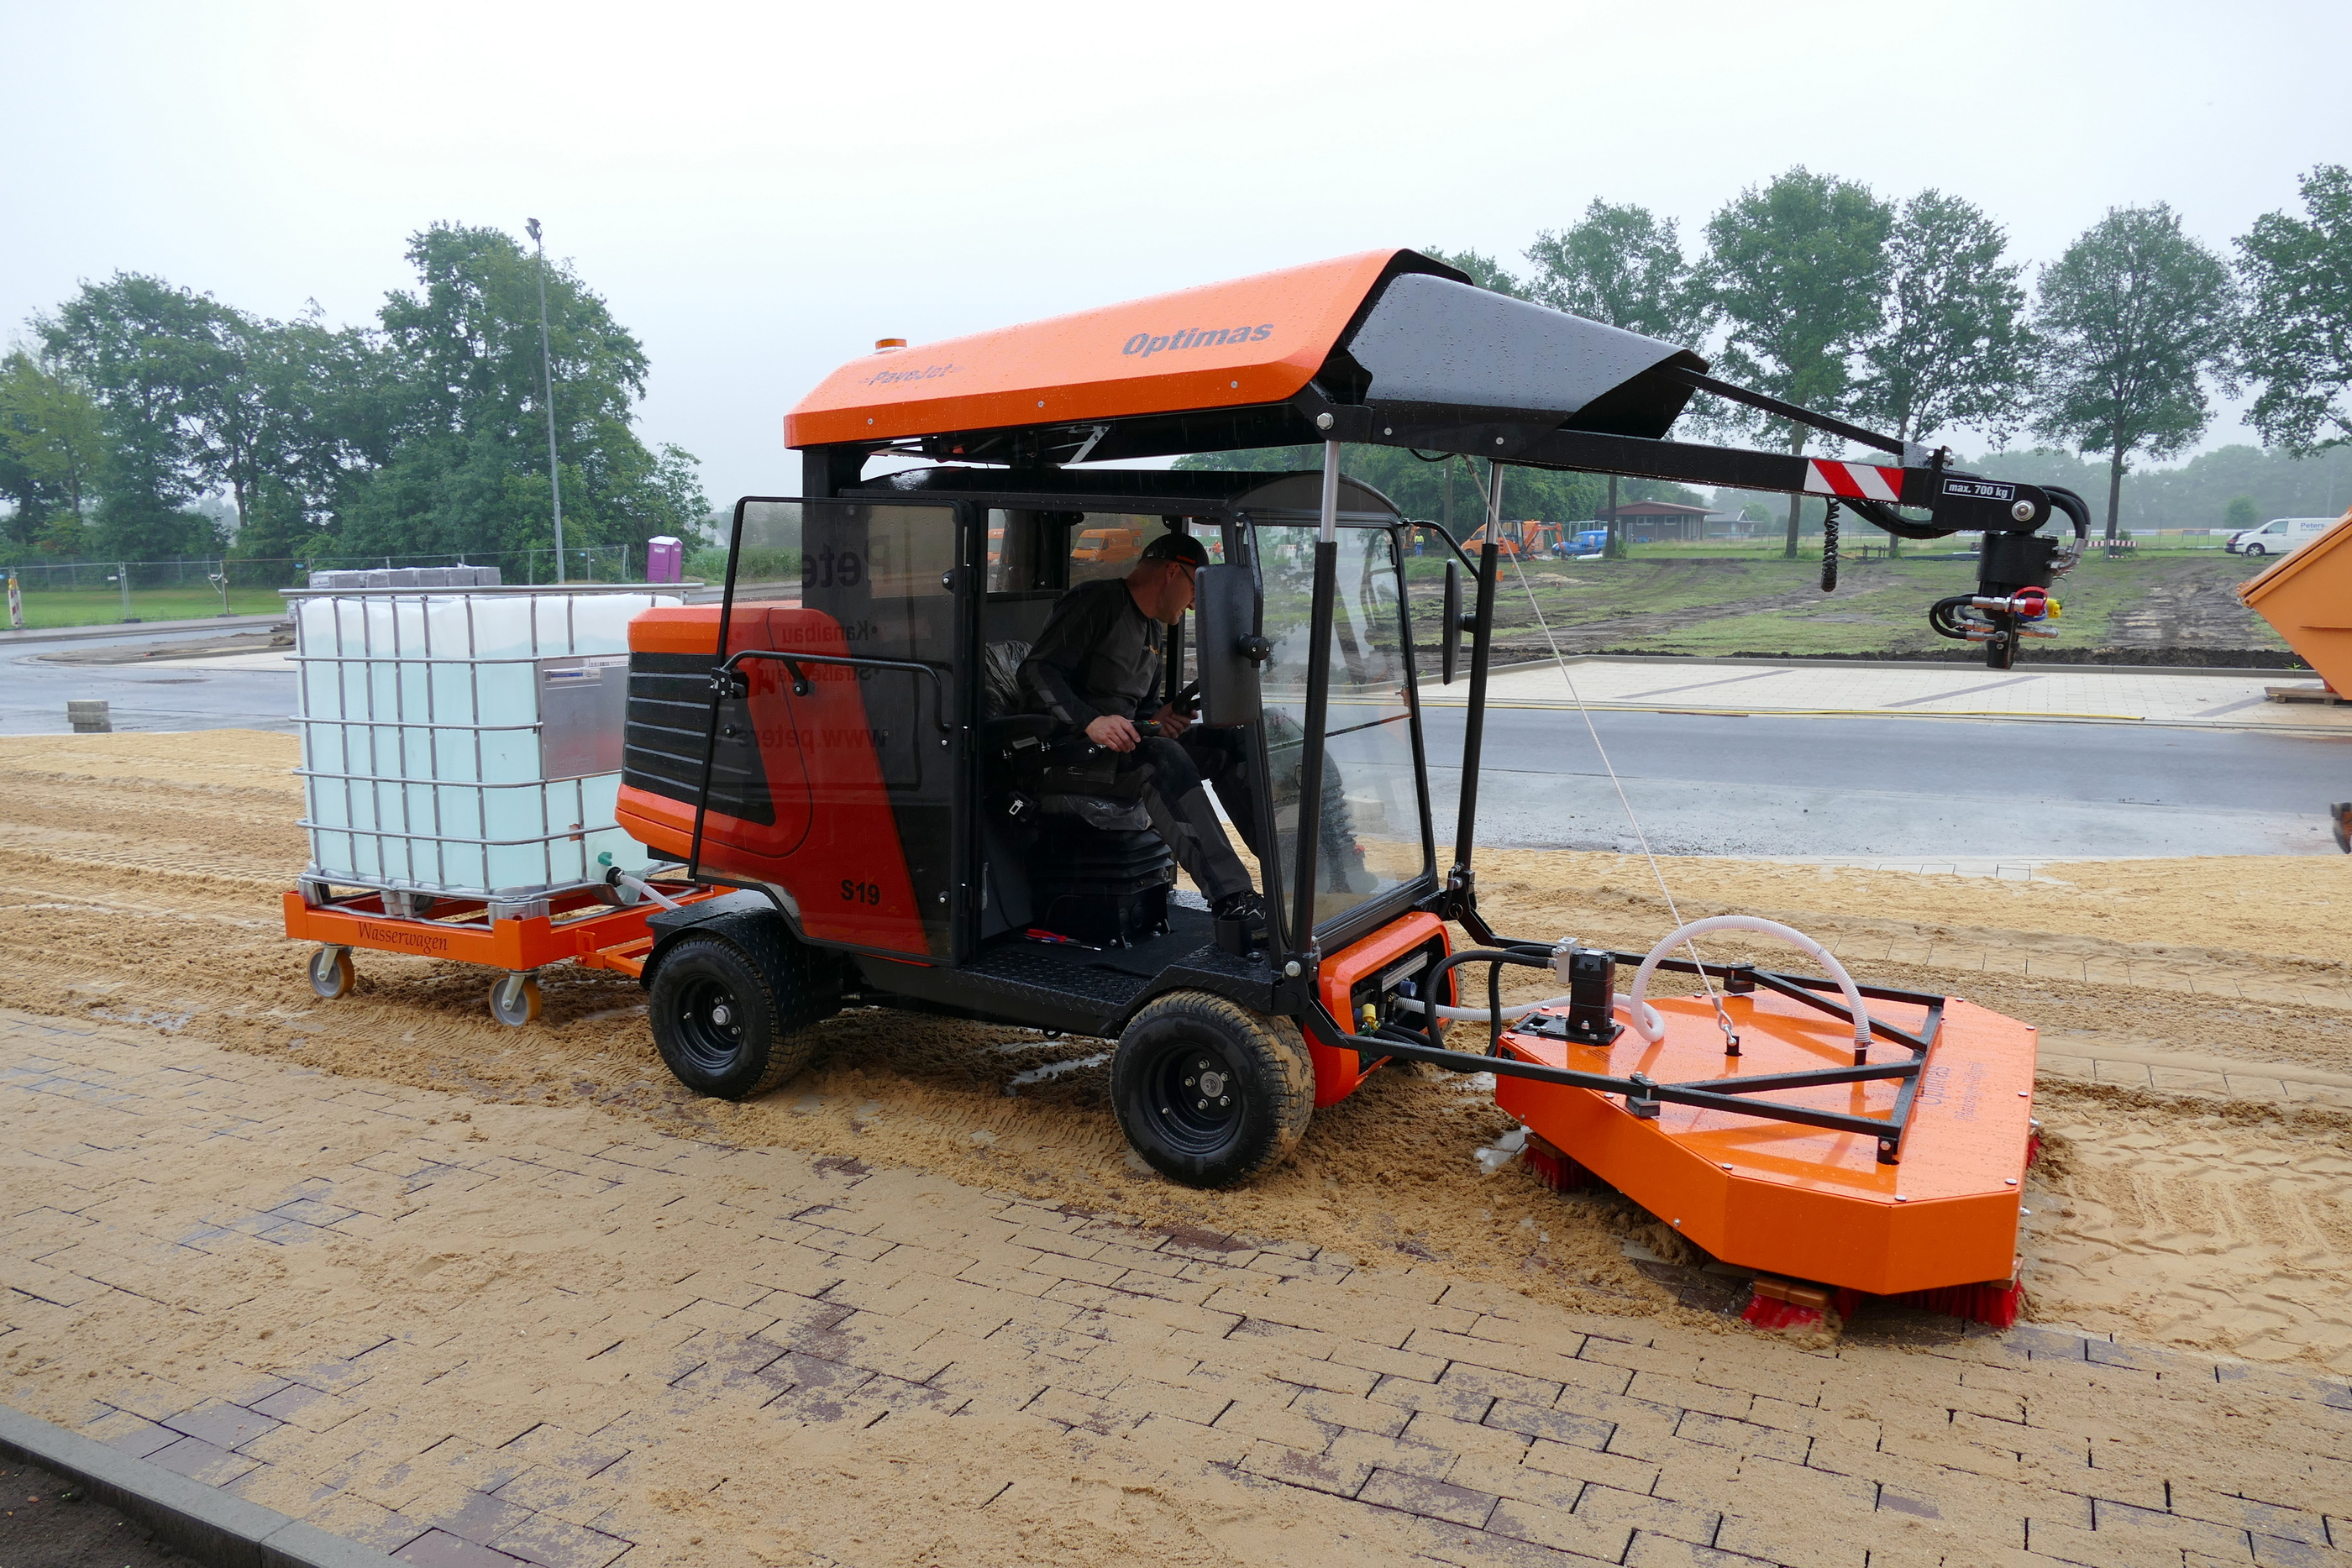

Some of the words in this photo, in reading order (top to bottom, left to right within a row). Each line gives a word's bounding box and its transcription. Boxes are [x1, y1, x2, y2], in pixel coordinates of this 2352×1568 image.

[1121, 323, 1275, 359] Optimas
[1949, 484, 1971, 494] max.
[1974, 485, 1993, 496] 700
[1995, 487, 2008, 499] kg
[840, 878, 880, 905] S19
[357, 920, 449, 956] Wasserwagen
[1914, 1066, 1950, 1105] Optimas
